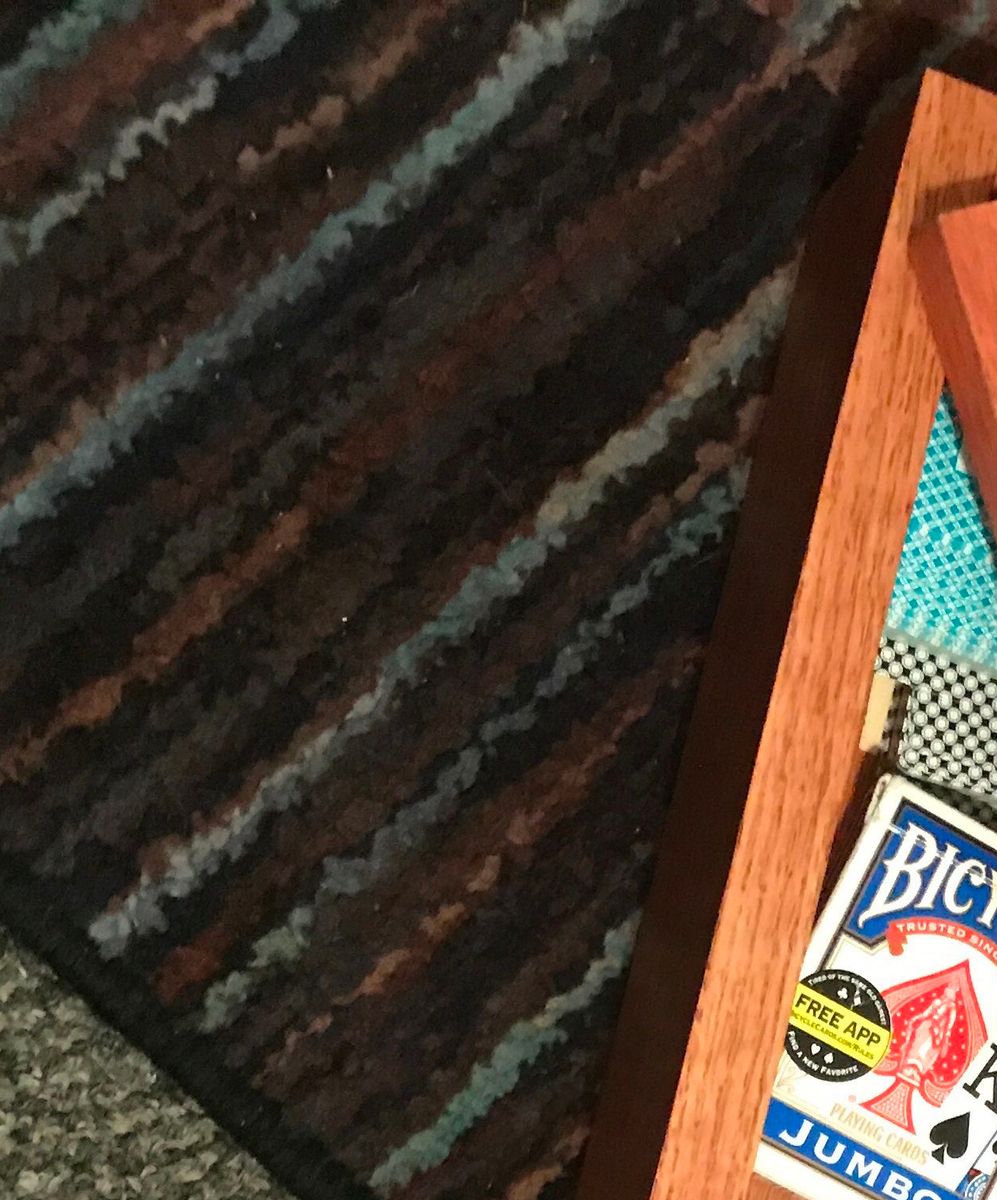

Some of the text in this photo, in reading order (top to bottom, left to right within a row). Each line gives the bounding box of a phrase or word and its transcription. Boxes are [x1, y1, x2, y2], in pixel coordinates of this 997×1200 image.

[896, 922, 966, 937] TRUSTED
[795, 993, 881, 1046] FREE APP
[802, 1056, 820, 1071] NEW
[820, 1065, 859, 1076] FAVORITE
[829, 1103, 929, 1166] PLAYING CARDS
